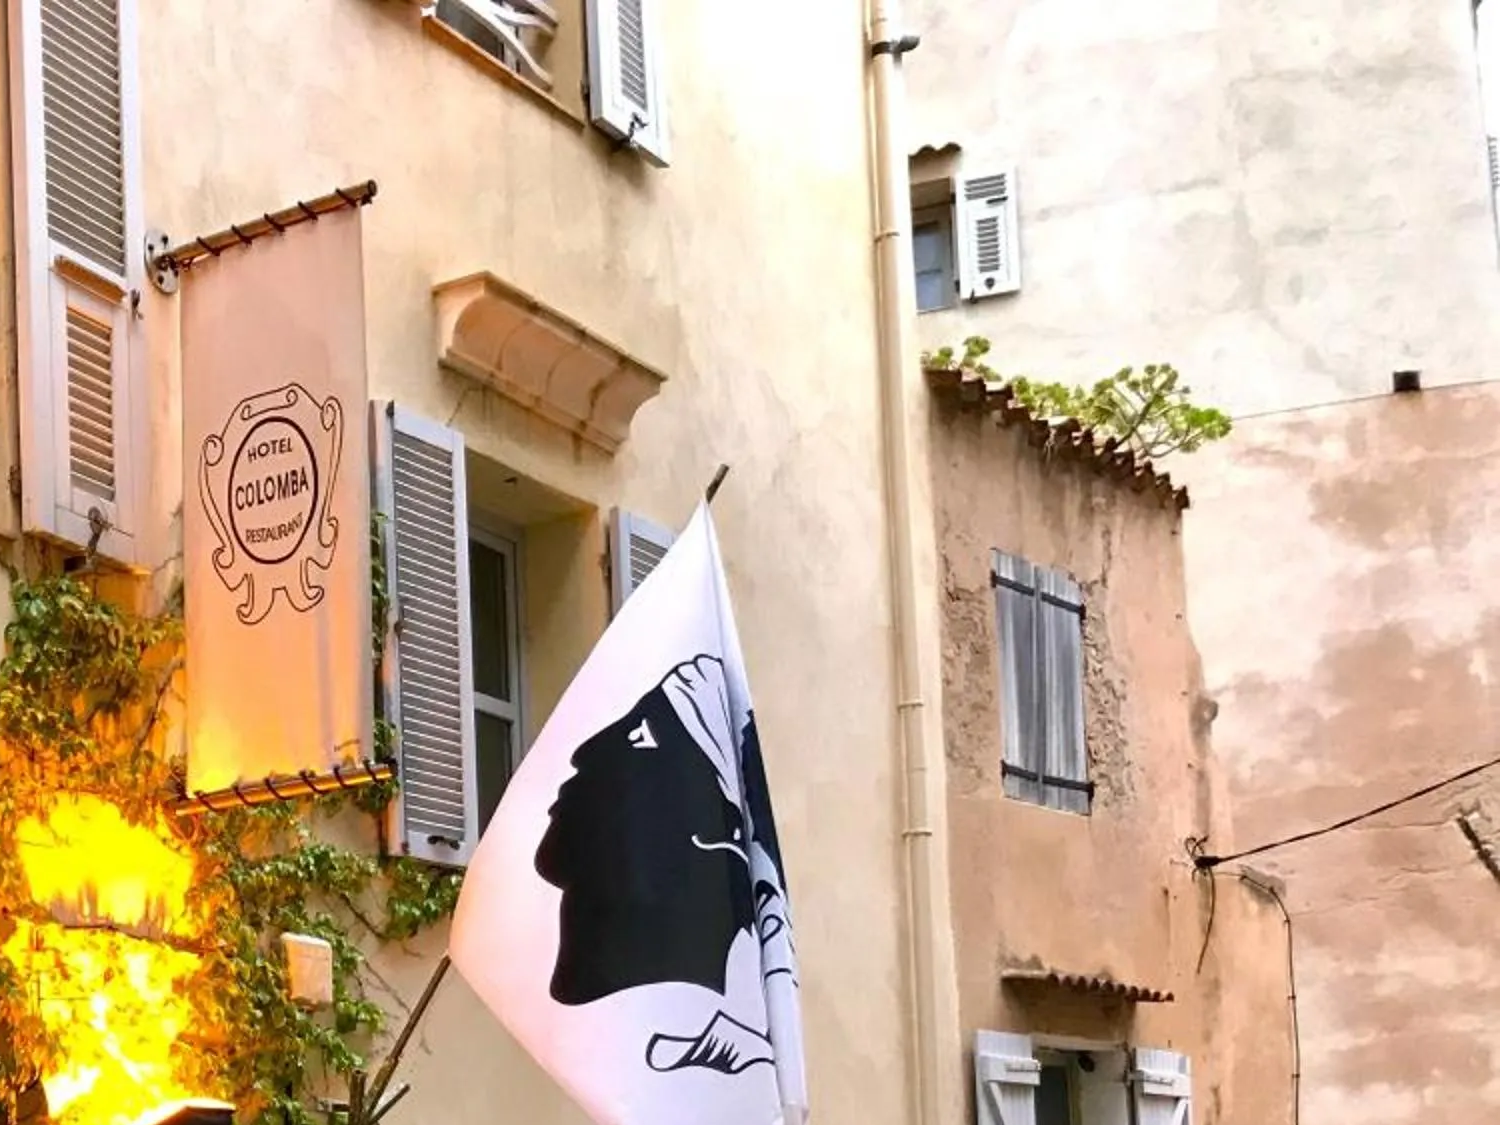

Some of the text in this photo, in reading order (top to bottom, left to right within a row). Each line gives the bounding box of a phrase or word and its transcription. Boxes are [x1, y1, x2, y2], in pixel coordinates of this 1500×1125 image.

[247, 437, 293, 463] HOTEL
[235, 466, 309, 511] COLOMBA
[245, 512, 303, 543] RESTAURANT
